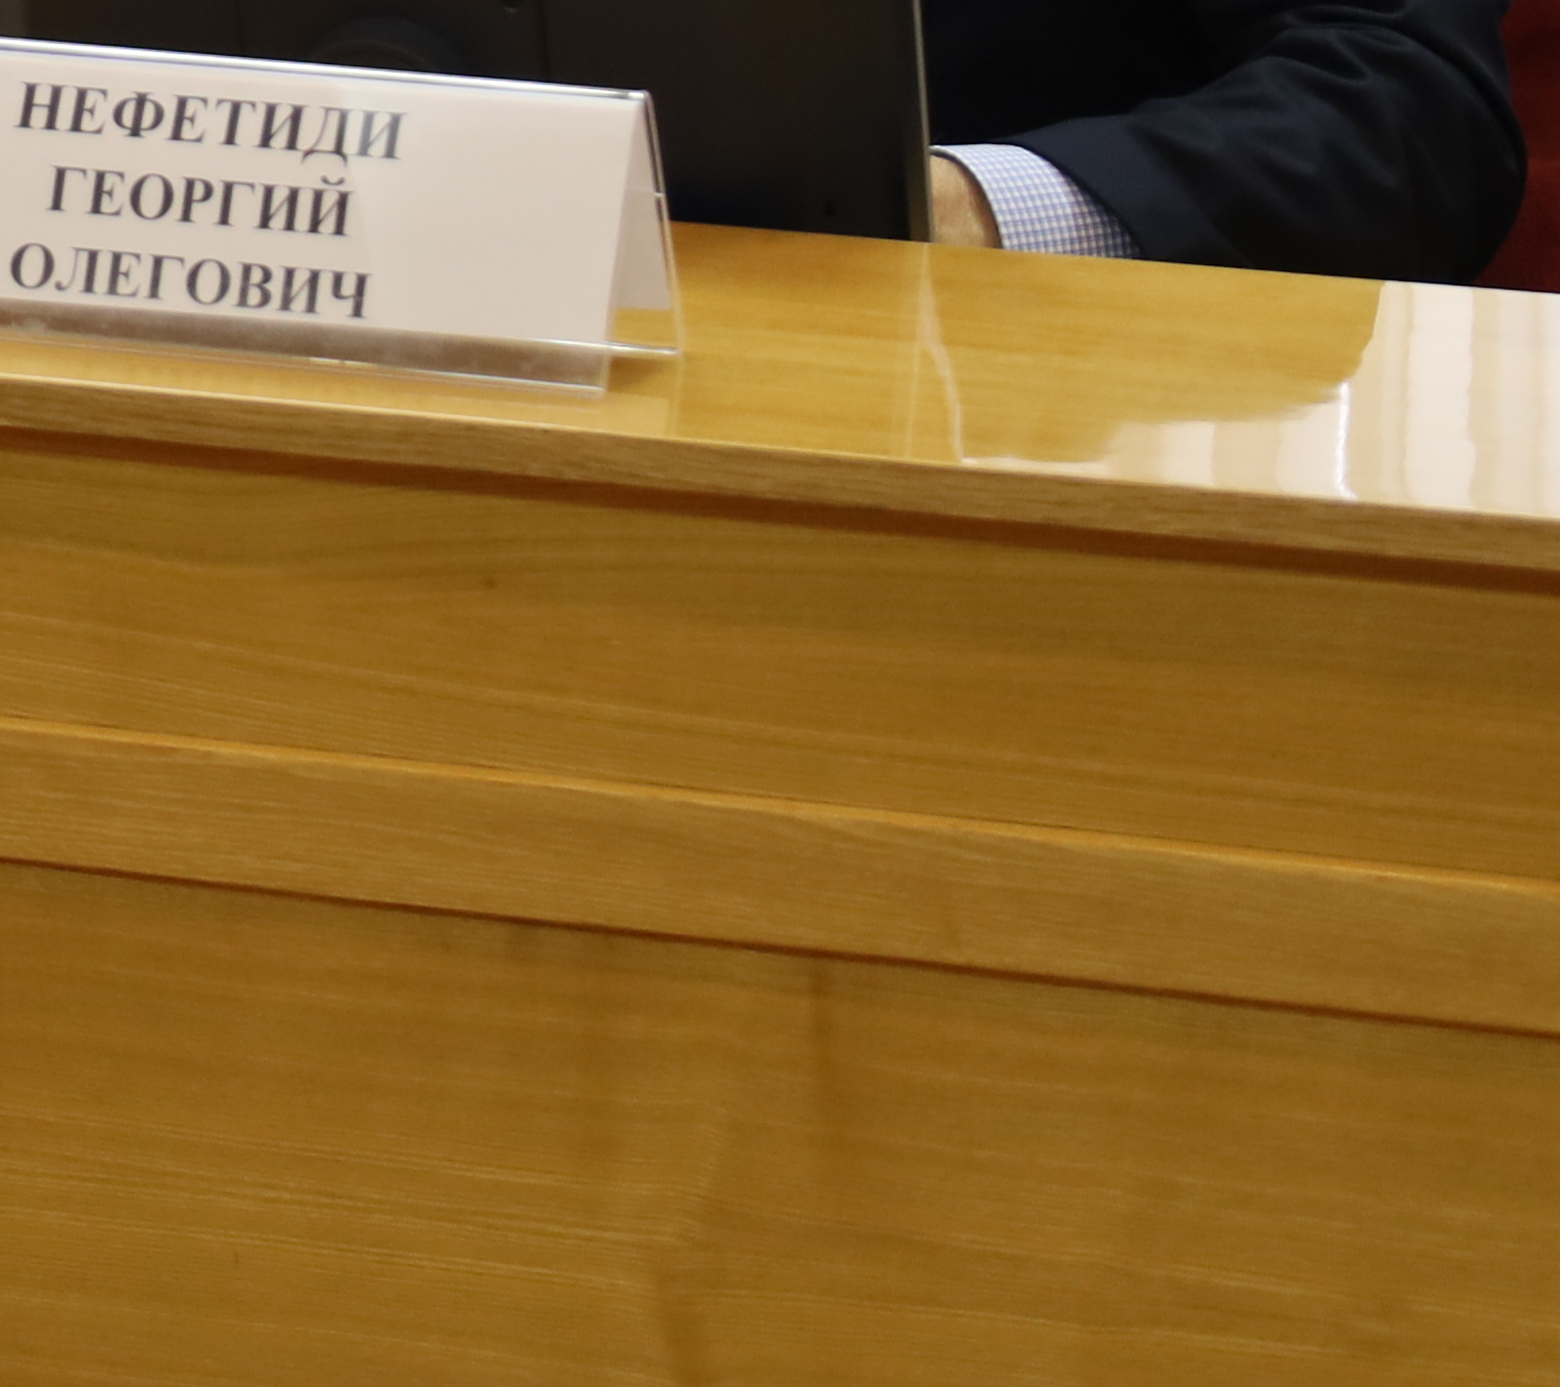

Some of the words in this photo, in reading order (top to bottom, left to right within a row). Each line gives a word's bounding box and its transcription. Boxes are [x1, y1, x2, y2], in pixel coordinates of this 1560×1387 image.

[15, 82, 407, 165] НЕФЕТИДИ
[46, 167, 355, 236] ГЕОРГИЙ
[9, 244, 373, 318] ОЛЕГОВИЧ
